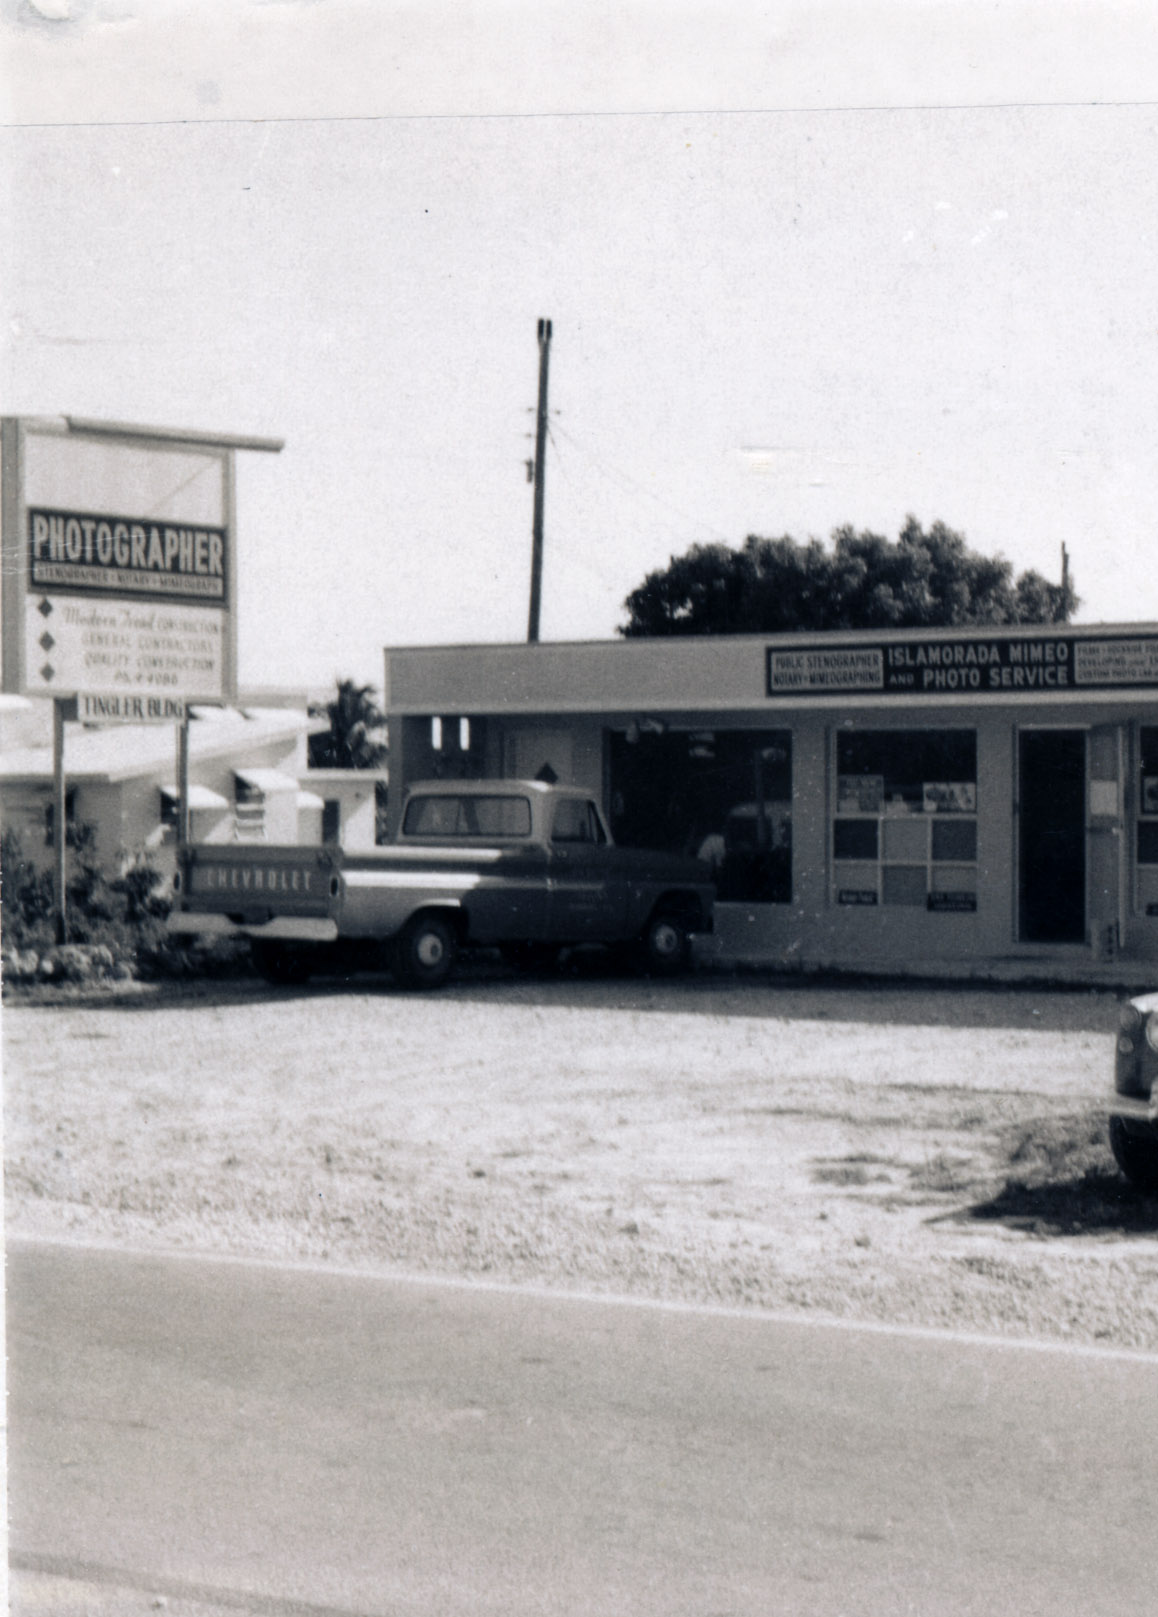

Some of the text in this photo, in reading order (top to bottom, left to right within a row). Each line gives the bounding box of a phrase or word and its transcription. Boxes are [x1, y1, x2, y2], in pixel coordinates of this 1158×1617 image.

[33, 513, 224, 575] PHOTOGRAPHER
[807, 653, 880, 668] STENOGRAPHER
[888, 641, 1069, 666] ISLAMORADA MIMEO
[889, 665, 1068, 689] AND PHOTO SERVICE
[83, 695, 144, 718] TINGLER
[207, 868, 312, 891] CHEVROLET
